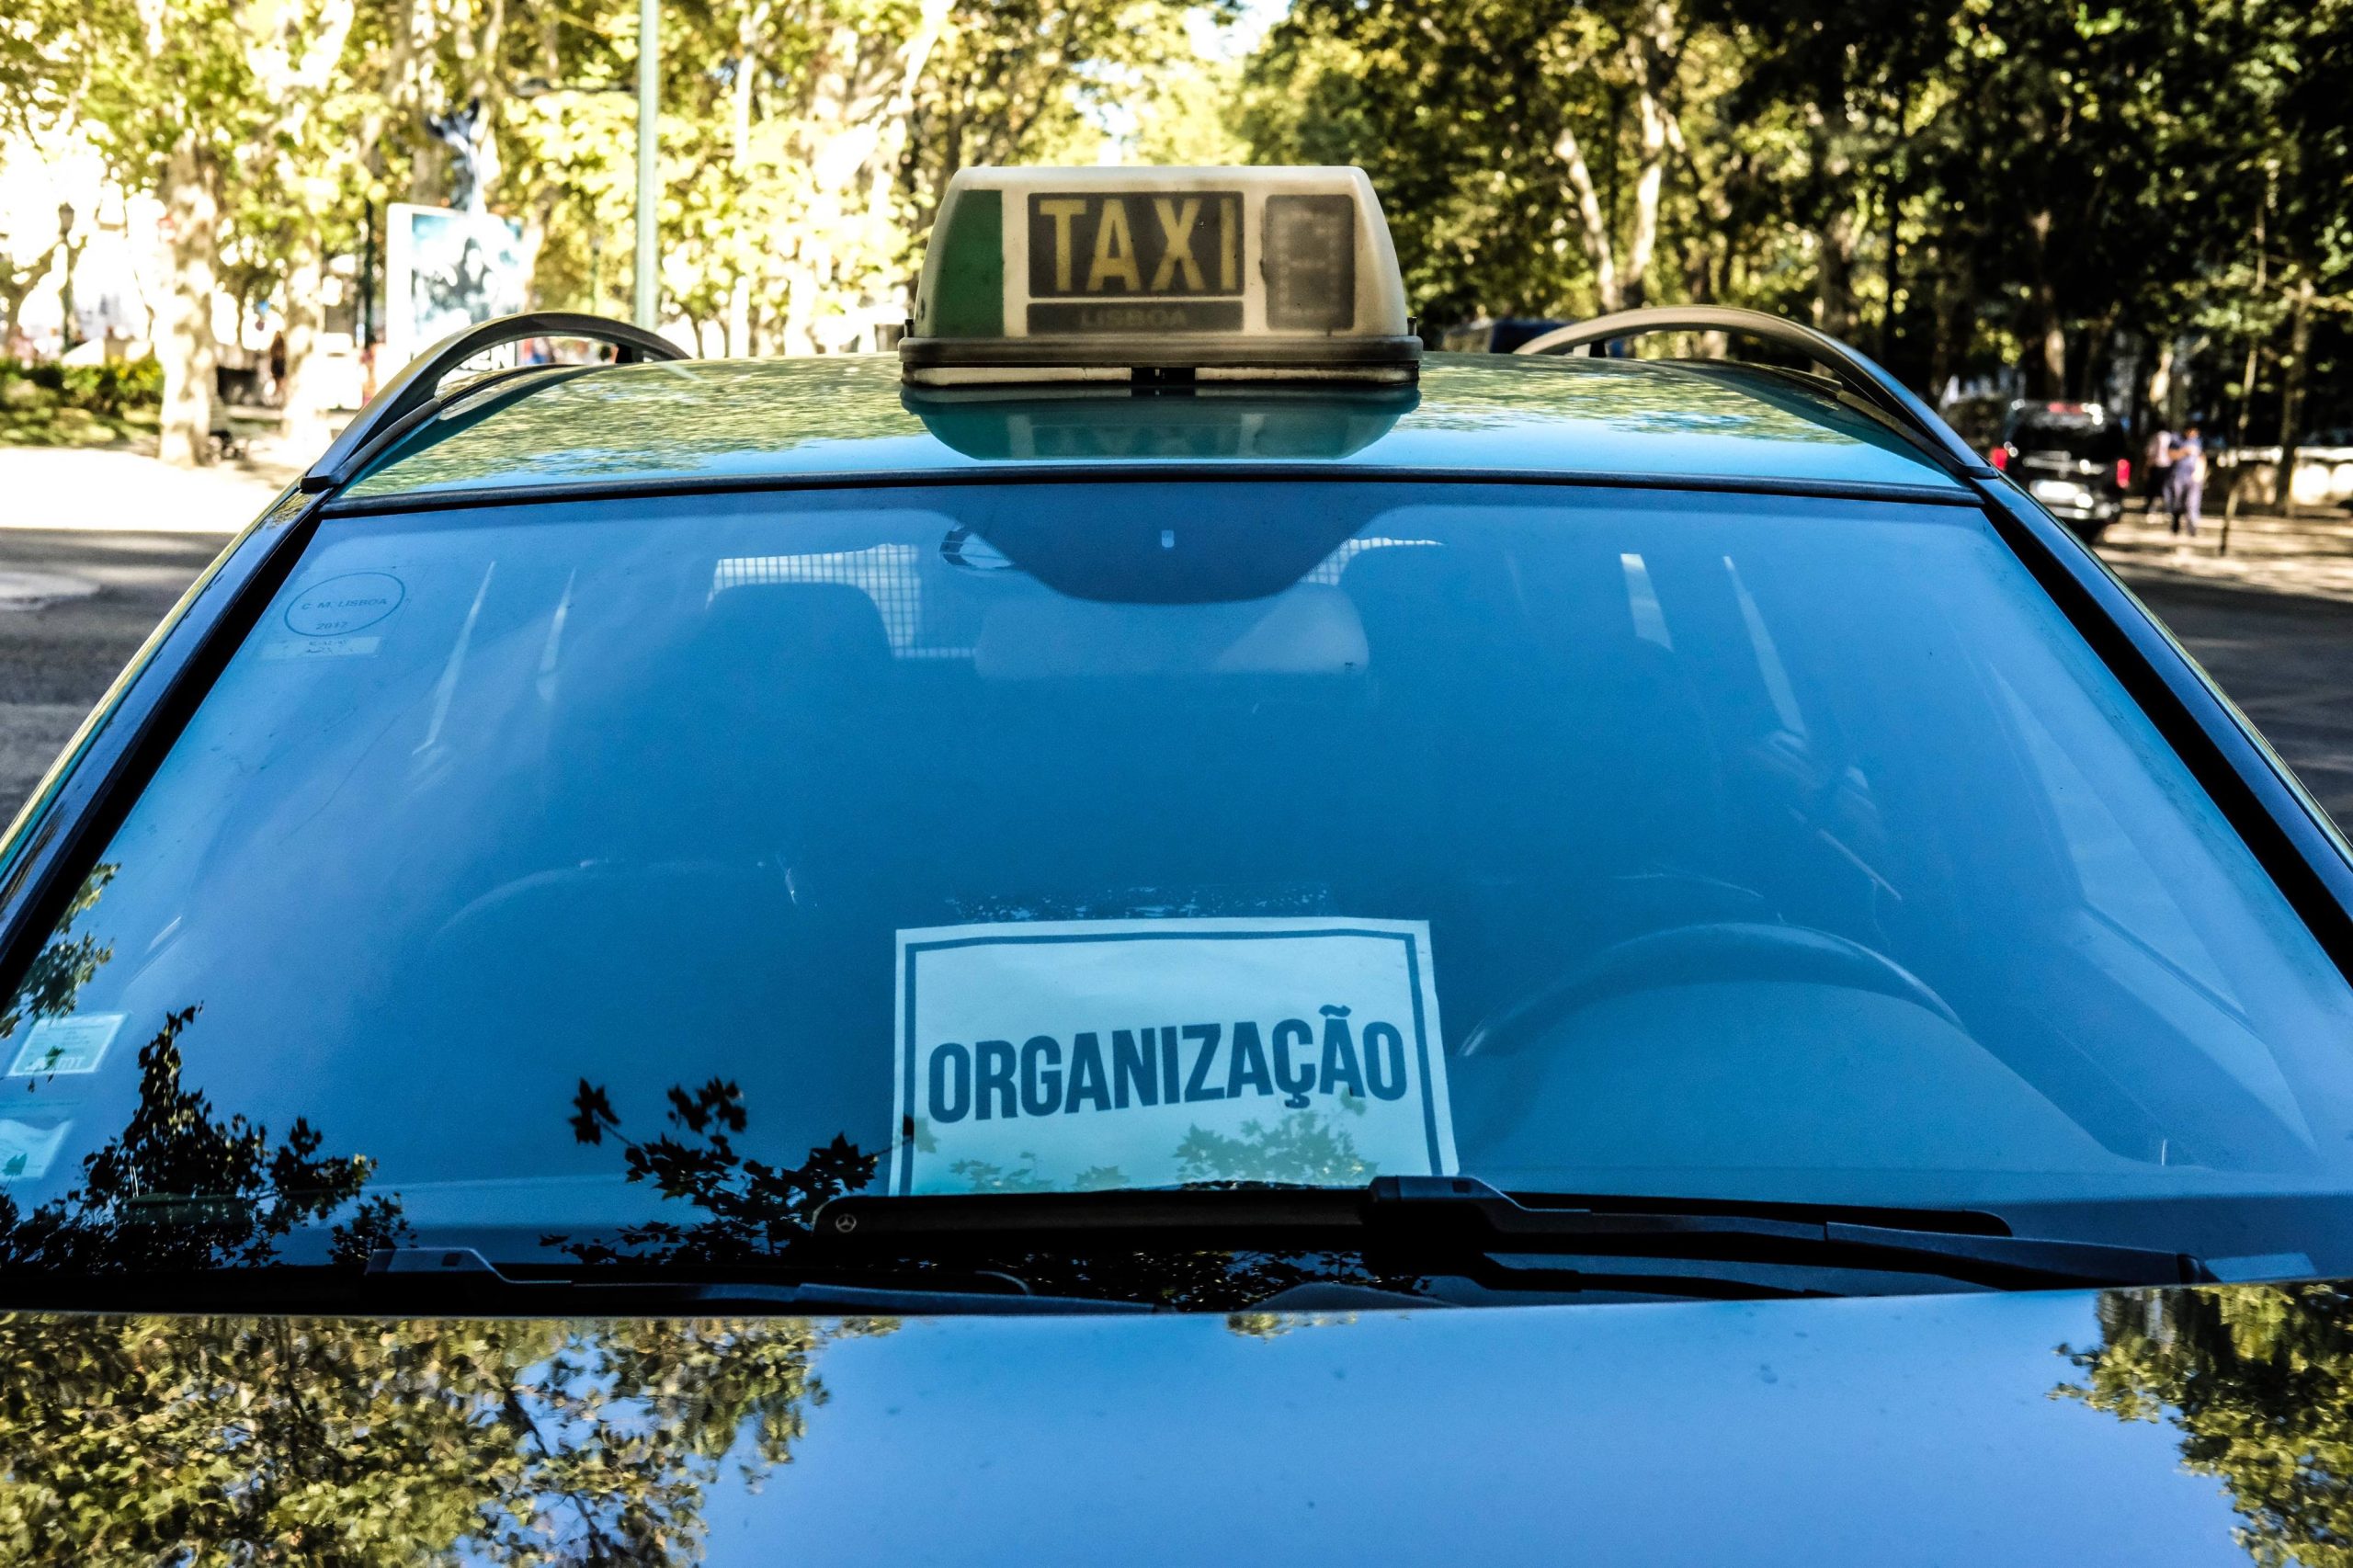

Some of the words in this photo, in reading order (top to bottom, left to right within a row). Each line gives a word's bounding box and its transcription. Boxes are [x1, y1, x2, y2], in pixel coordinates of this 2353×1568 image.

[1039, 199, 1237, 291] TAXI
[1081, 309, 1188, 328] LISBOA
[337, 598, 387, 608] LISBOA
[927, 1004, 1408, 1124] ORGANIZAÇÃO
